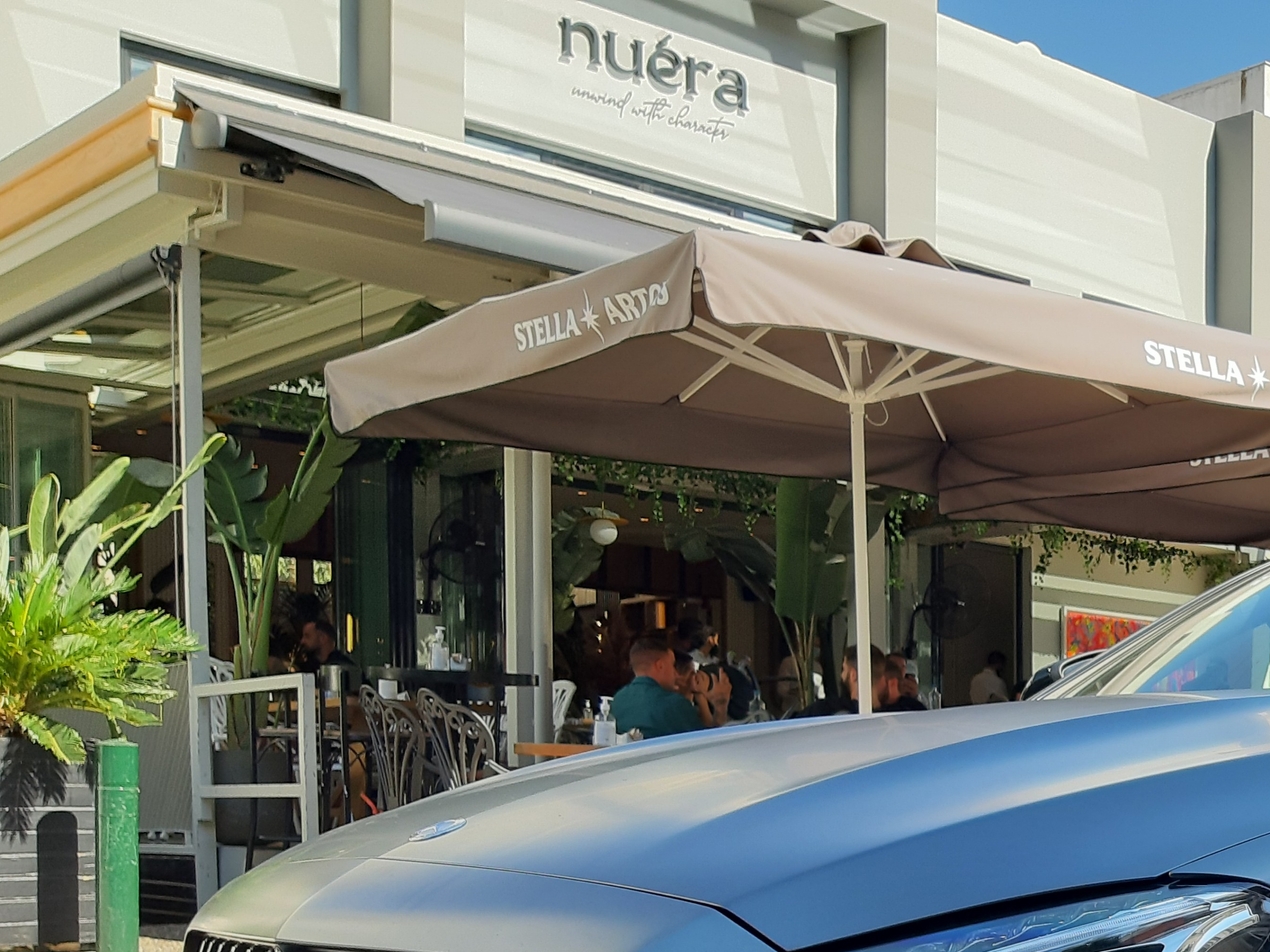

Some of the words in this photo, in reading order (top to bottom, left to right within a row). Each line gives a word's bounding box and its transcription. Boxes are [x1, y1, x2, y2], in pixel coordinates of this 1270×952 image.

[558, 17, 750, 117] nuéra
[571, 85, 633, 118] unwind
[631, 97, 672, 125] with
[668, 105, 735, 142] character
[514, 308, 582, 351] STELLA
[603, 281, 669, 325] ARTOS
[1143, 340, 1245, 387] STELLA
